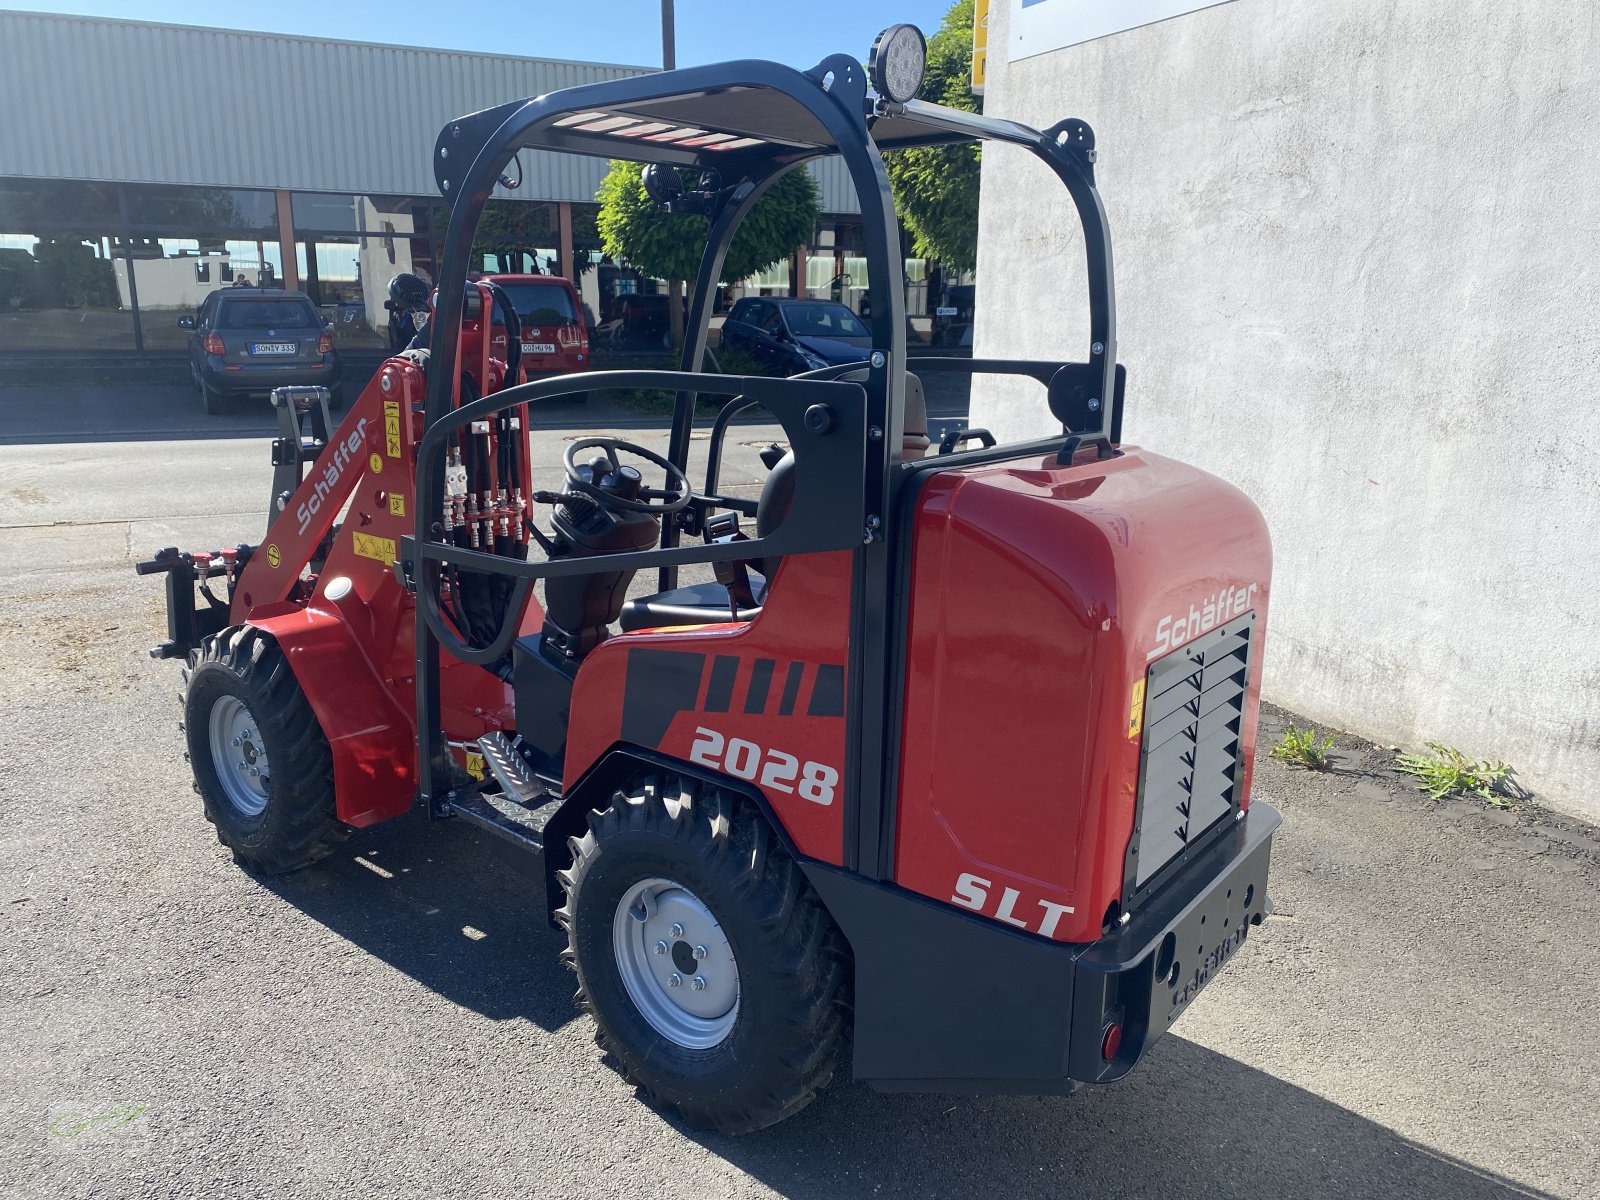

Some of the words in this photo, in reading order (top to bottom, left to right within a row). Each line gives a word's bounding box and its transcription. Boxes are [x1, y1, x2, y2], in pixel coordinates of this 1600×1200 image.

[256, 344, 271, 352] SON
[280, 344, 295, 352] 333
[297, 418, 367, 536] Schäffer
[1146, 583, 1257, 661] Schäffer
[689, 726, 839, 806] 2028
[951, 872, 1075, 939] SLT
